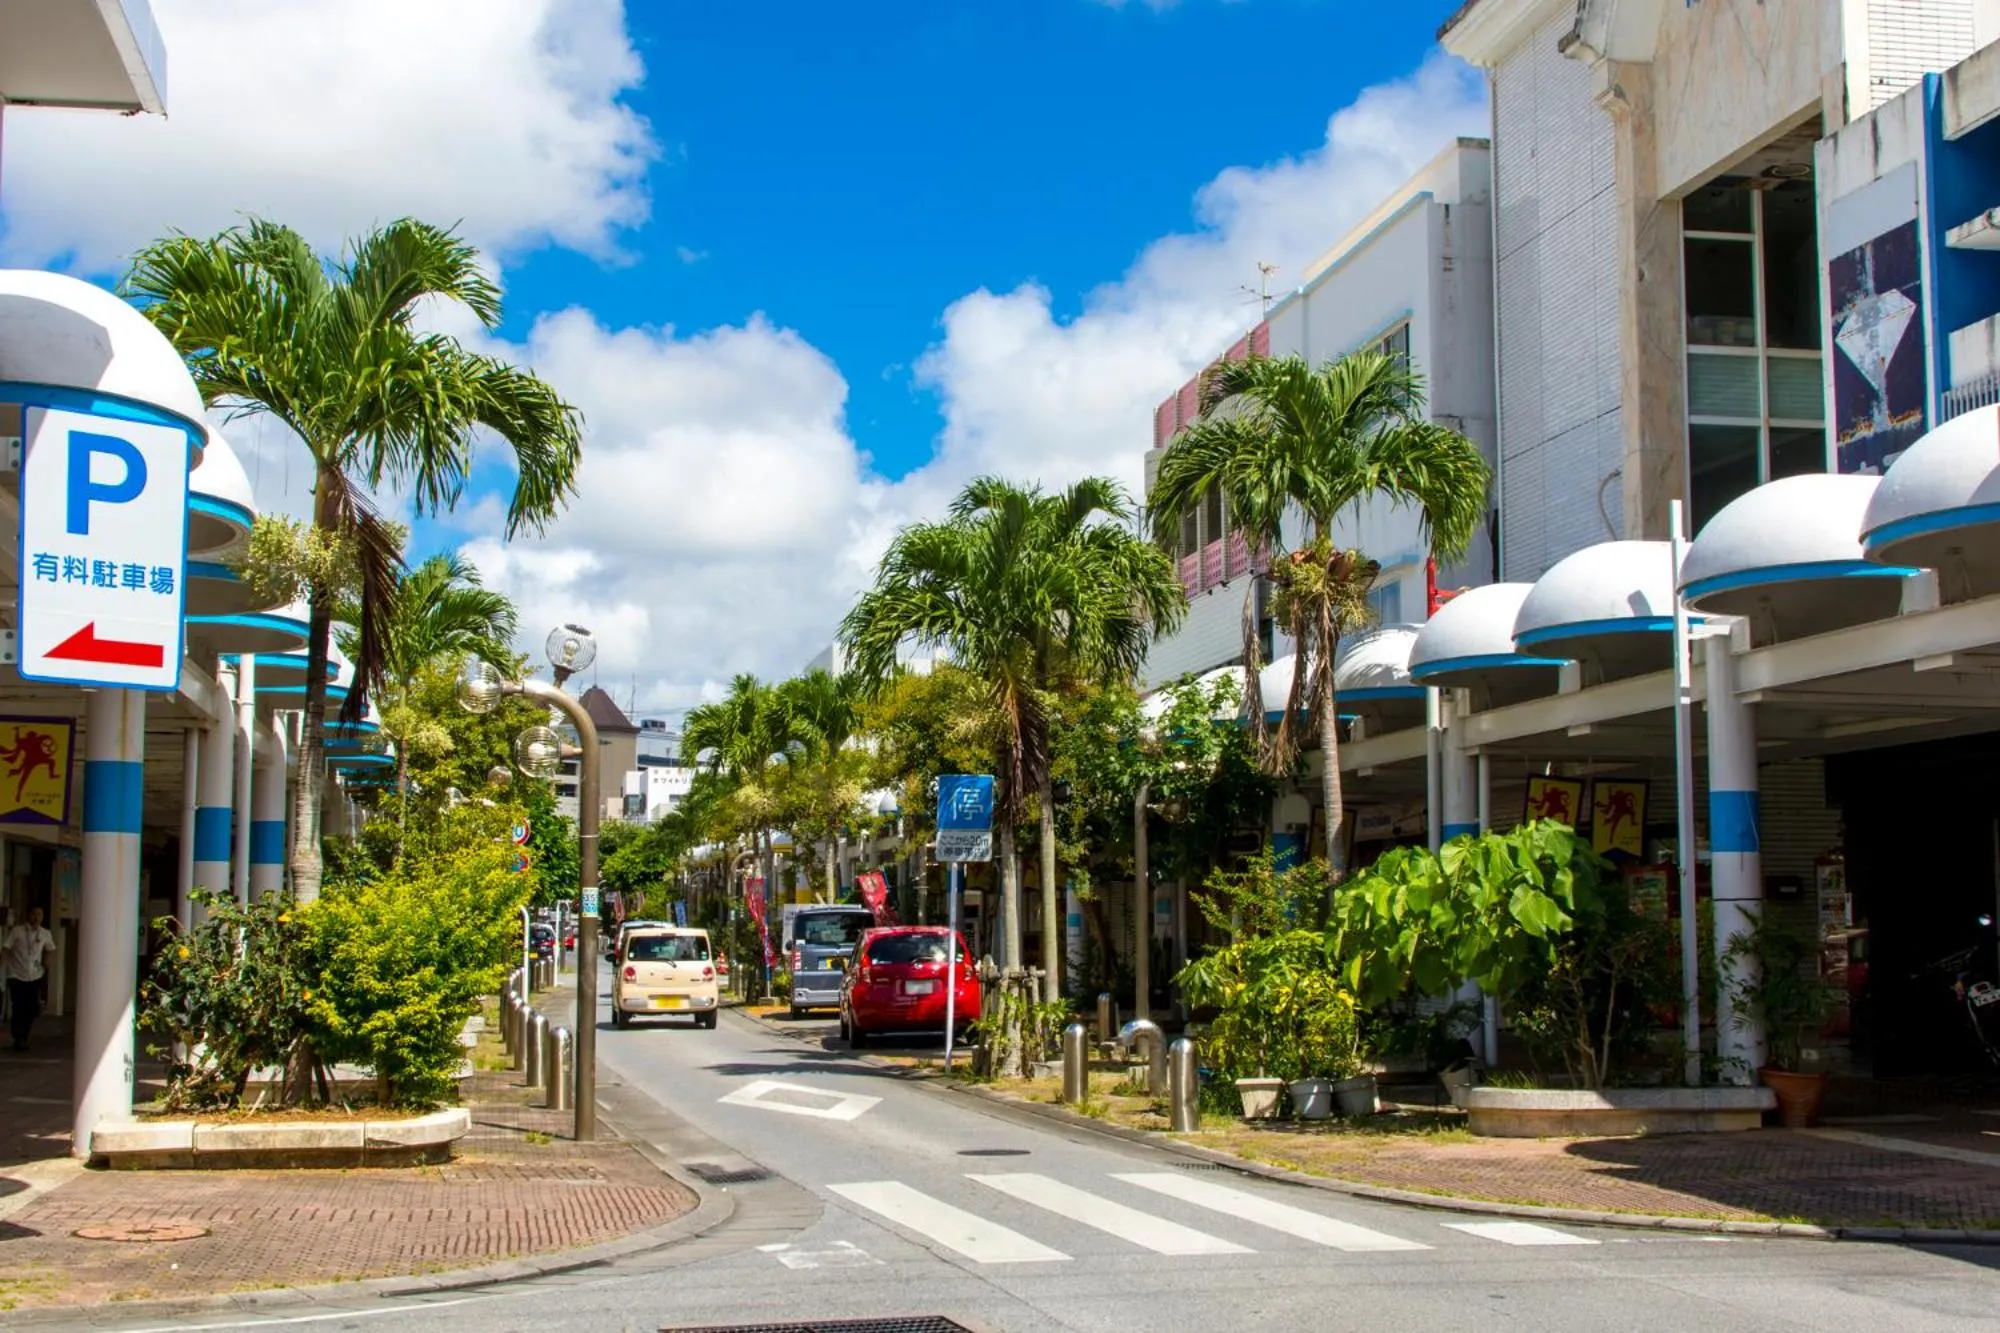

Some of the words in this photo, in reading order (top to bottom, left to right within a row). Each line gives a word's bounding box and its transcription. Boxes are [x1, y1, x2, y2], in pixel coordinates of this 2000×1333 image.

[66, 429, 148, 536] P
[31, 551, 175, 595] 有料駐車場
[947, 785, 983, 821] 停
